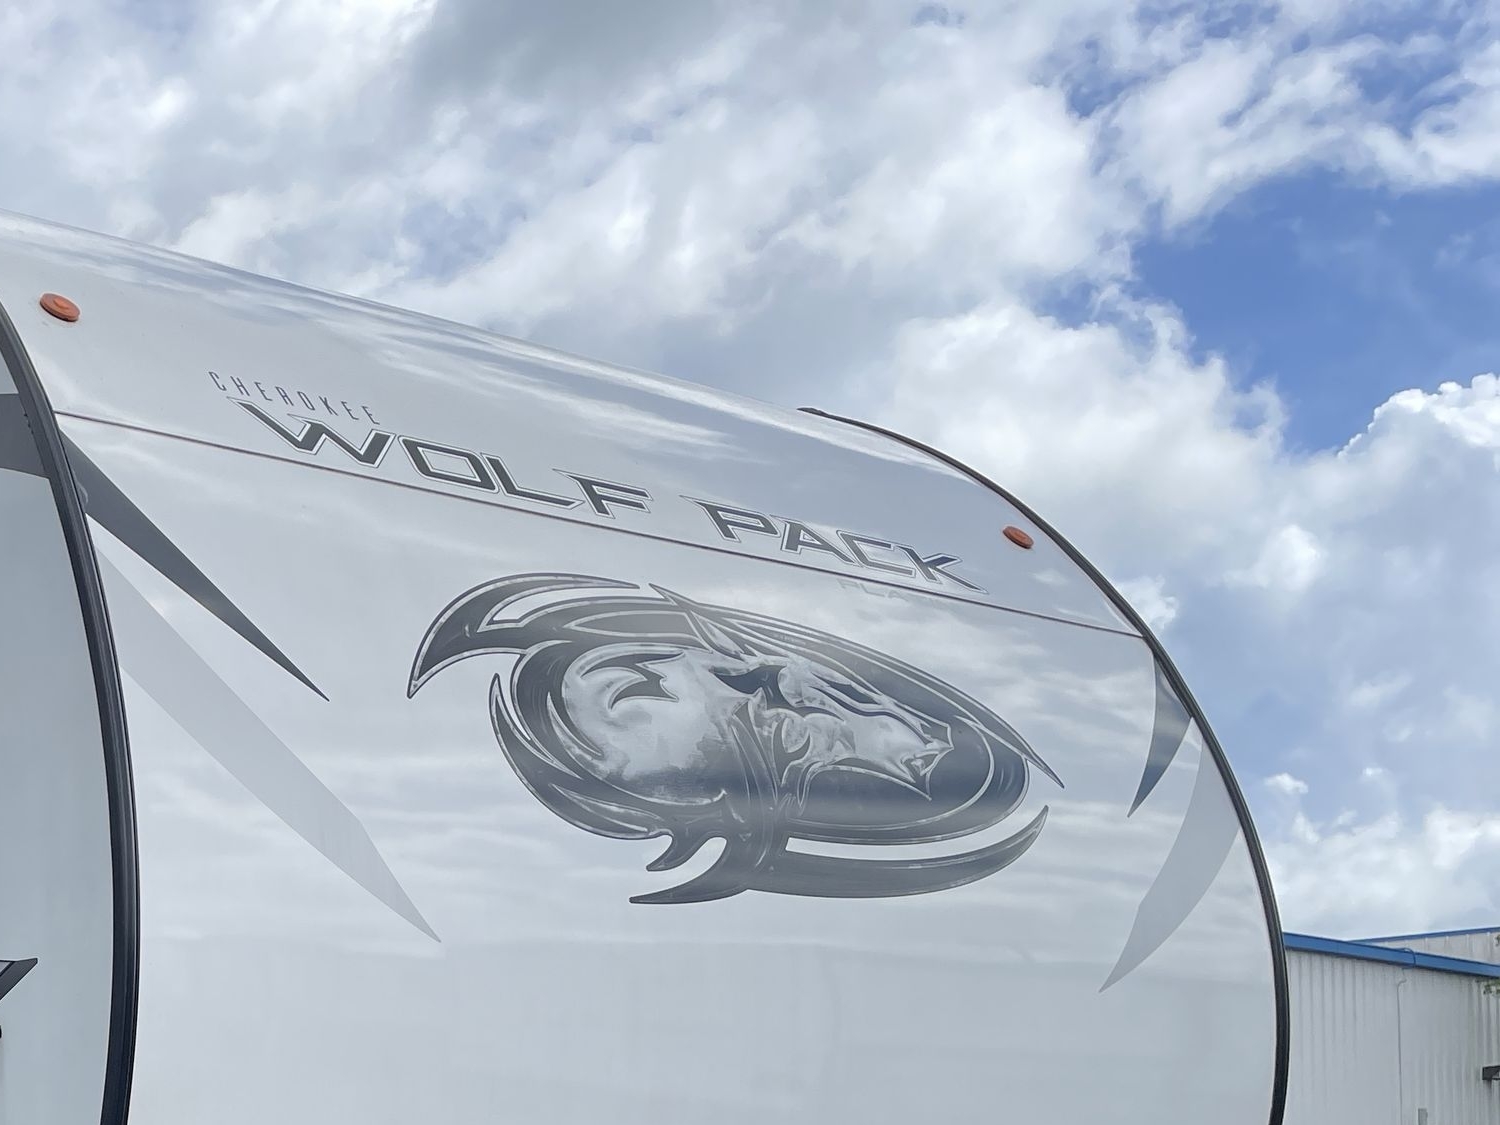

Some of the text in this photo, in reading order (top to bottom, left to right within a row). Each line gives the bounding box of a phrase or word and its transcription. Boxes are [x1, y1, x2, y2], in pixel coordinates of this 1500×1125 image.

[208, 370, 381, 426] CHEROKEE
[226, 396, 990, 595] WOLF PACK
